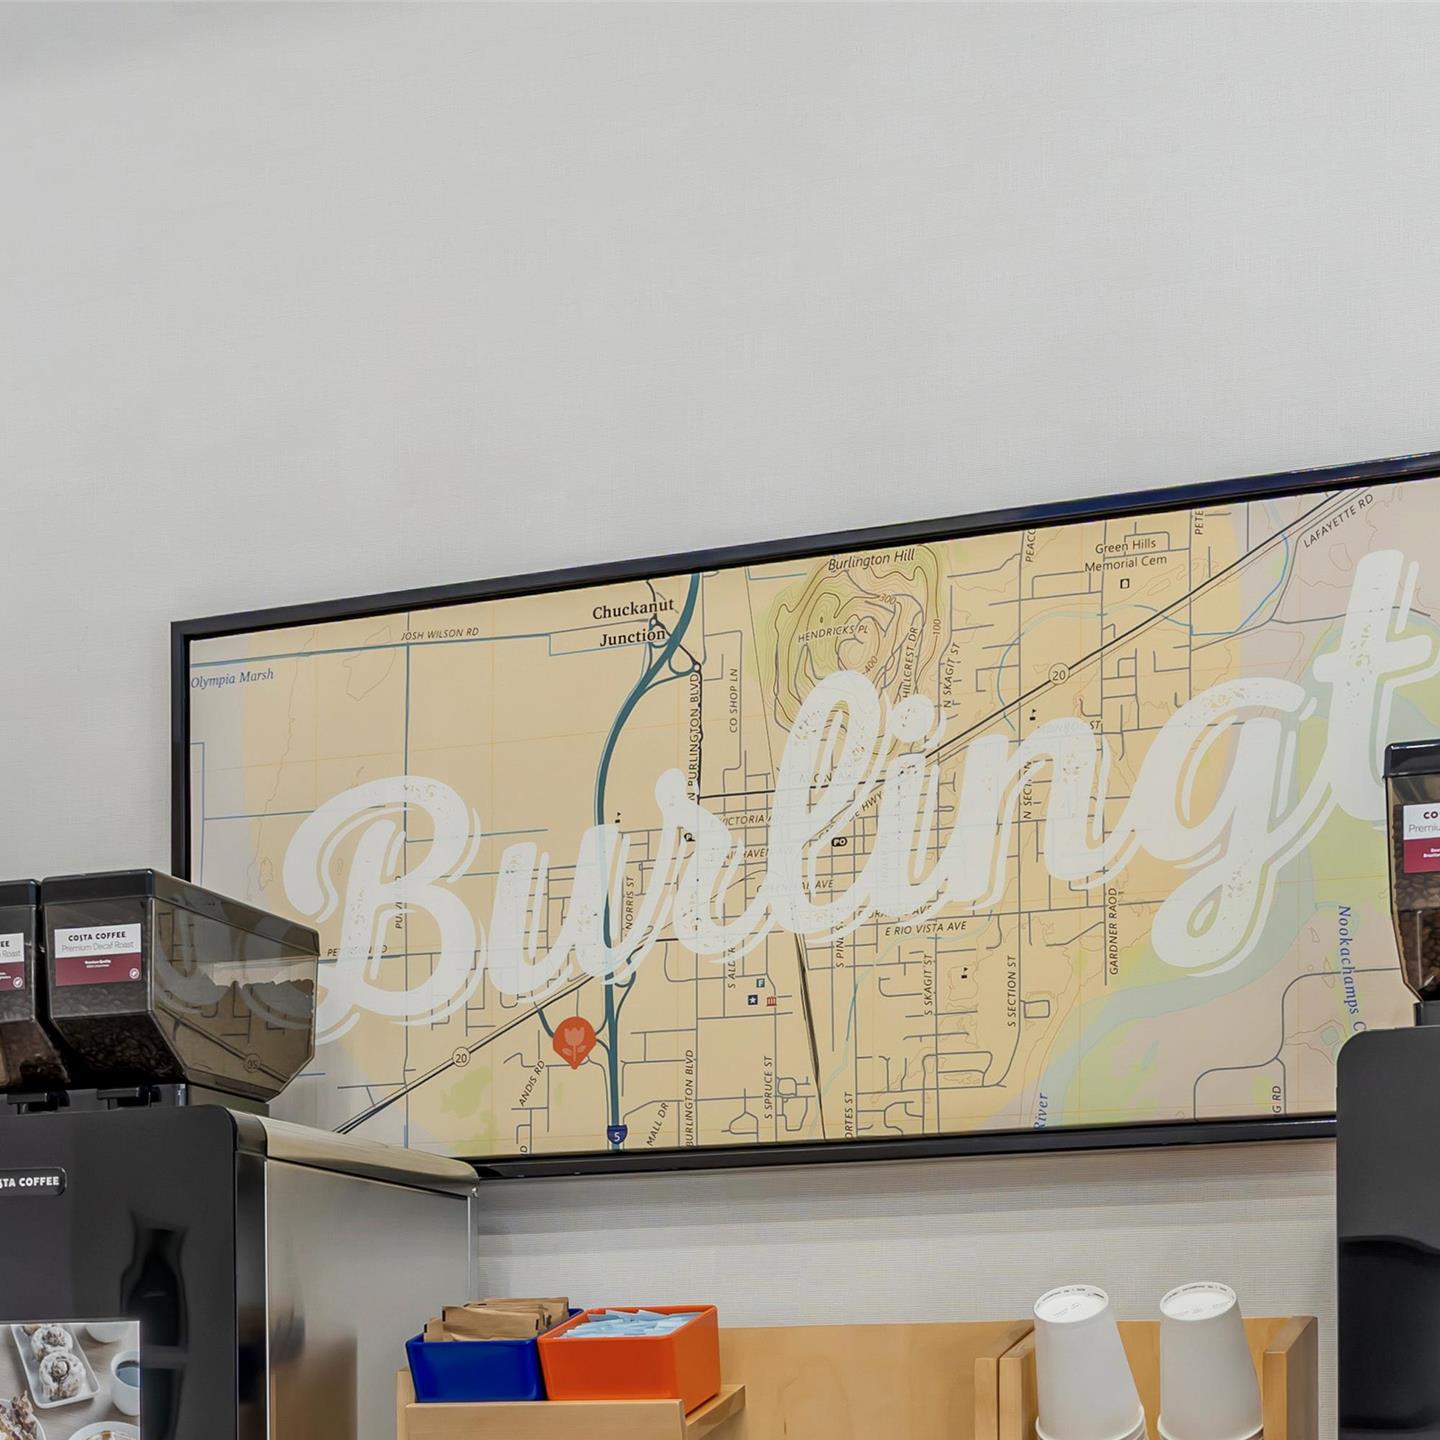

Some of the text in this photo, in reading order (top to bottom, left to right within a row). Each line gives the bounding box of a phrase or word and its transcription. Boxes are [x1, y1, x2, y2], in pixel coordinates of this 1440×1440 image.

[1303, 494, 1373, 548] LAFAYETTE RD
[1095, 538, 1156, 554] Green Hills
[828, 549, 915, 571] Burlington Hill
[1085, 555, 1167, 572] Memorial Cem
[879, 593, 897, 604] 300
[592, 599, 674, 620] Chuckanut
[401, 627, 480, 641] JOSH WILSON RD
[798, 624, 869, 643] HENDRICKS PL
[933, 619, 941, 636] 100
[600, 628, 666, 648] Junction
[902, 626, 918, 699] HILLCREST DR
[191, 668, 274, 689] Olympia Marsh
[943, 643, 960, 708] N SKAGIT ST
[1051, 670, 1066, 681] 20
[689, 673, 699, 703] BLVD
[729, 668, 738, 733] CO SHOP LN
[862, 791, 883, 811] HWY
[625, 876, 635, 930] NORRIS ST
[68, 931, 126, 942] COSTA COFFEE
[885, 921, 966, 936] E RIO VISTA AVE
[1108, 888, 1118, 975] GARDNER RAOD
[3, 950, 21, 958] Roast
[62, 941, 134, 952] Premium Decaf Roast
[836, 937, 844, 959] PIN
[924, 954, 933, 966] ST
[1007, 955, 1016, 967] ST
[1338, 905, 1359, 1014] Nookachamps
[924, 971, 933, 1006] SKAGIT
[1007, 971, 1016, 1018] SECTION
[455, 1053, 468, 1064] 20
[534, 1060, 545, 1076] RD
[764, 1056, 773, 1067] ST
[685, 1050, 694, 1146] BURLINGTON BLVD
[764, 1071, 773, 1111] SPRUCE
[844, 1092, 853, 1104] ST
[1272, 1085, 1282, 1101] RD
[1033, 1093, 1048, 1129] River
[646, 1102, 670, 1146] MALL DR
[614, 1132, 620, 1141] 5
[19, 1176, 59, 1187] COFFEE
